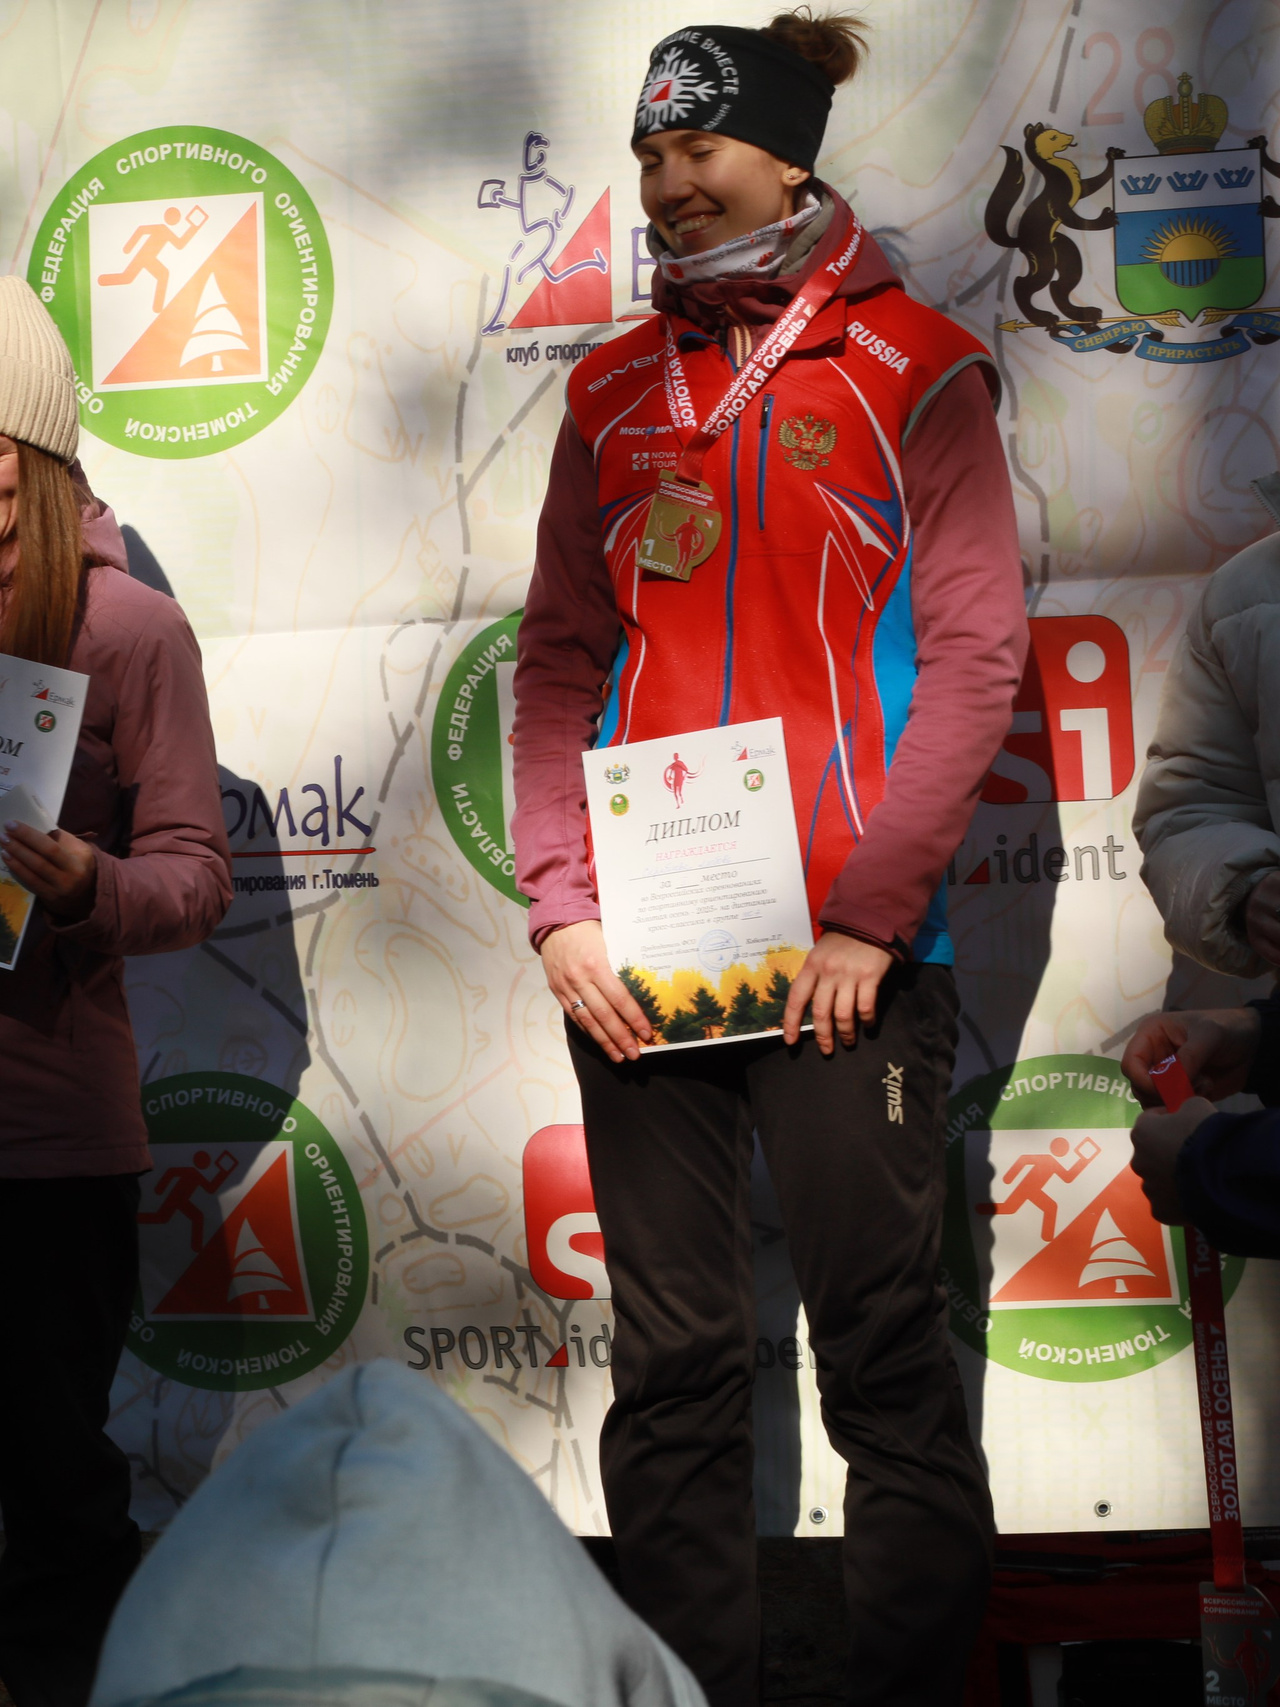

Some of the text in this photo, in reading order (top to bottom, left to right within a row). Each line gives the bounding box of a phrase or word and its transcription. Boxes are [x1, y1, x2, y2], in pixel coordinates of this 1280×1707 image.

[700, 37, 739, 95] ВМЕСТЕ
[825, 233, 860, 276] Тюмень
[39, 142, 319, 442] ФЕДЕРАЦИЯ СПОРТИВНОГО ОРИЕНТИРОВАНИЯ ТЮМЕНСКОЙ
[506, 341, 539, 366] клуб
[846, 320, 910, 375] RUSSIA
[1074, 319, 1147, 350] СИБИРЬЮ
[1145, 338, 1242, 360] ПРИРАСТАТЬ
[700, 296, 807, 435] ВСЕРОССИЙСКИЕ СОРЕВНОВАНИЯ
[710, 318, 808, 438] ЗОЛОТАЯ ОСЕНЬ
[669, 358, 697, 427] ЗОЛОТАЯ
[651, 451, 677, 460] NOVA
[651, 459, 677, 469] TOUR
[638, 557, 674, 574] МЕСТО
[643, 538, 655, 557] 1
[447, 633, 516, 876] ФЕДЕРАЦИЯ ОБЛАСТИ
[644, 810, 741, 846] ДИПЛОМ
[655, 841, 738, 862] НАГРАЖДАЕТСЯ
[996, 833, 1128, 884] ident
[312, 868, 380, 891] г.Тюмень
[700, 870, 738, 883] место
[881, 1061, 904, 1125] swix
[146, 1087, 353, 1376] СПОРТИВНОГО ОРИЕНТИРОВАНИЯ ТЮМЕНСКОЙ
[403, 1324, 541, 1371] SPORT
[1017, 1323, 1171, 1366] ТЮМЕНСКОЙ
[1195, 1321, 1222, 1523] ВСЕРОССИЙСКИЕ СОРЕВНОВАНИЯ
[1210, 1339, 1240, 1523] ЗОЛОТАЯ ОСЕНЬ
[1203, 1606, 1260, 1616] СОРЕВНОВАНИЯ
[1205, 1670, 1220, 1693] 2
[1206, 1695, 1246, 1707] МЕСТО
